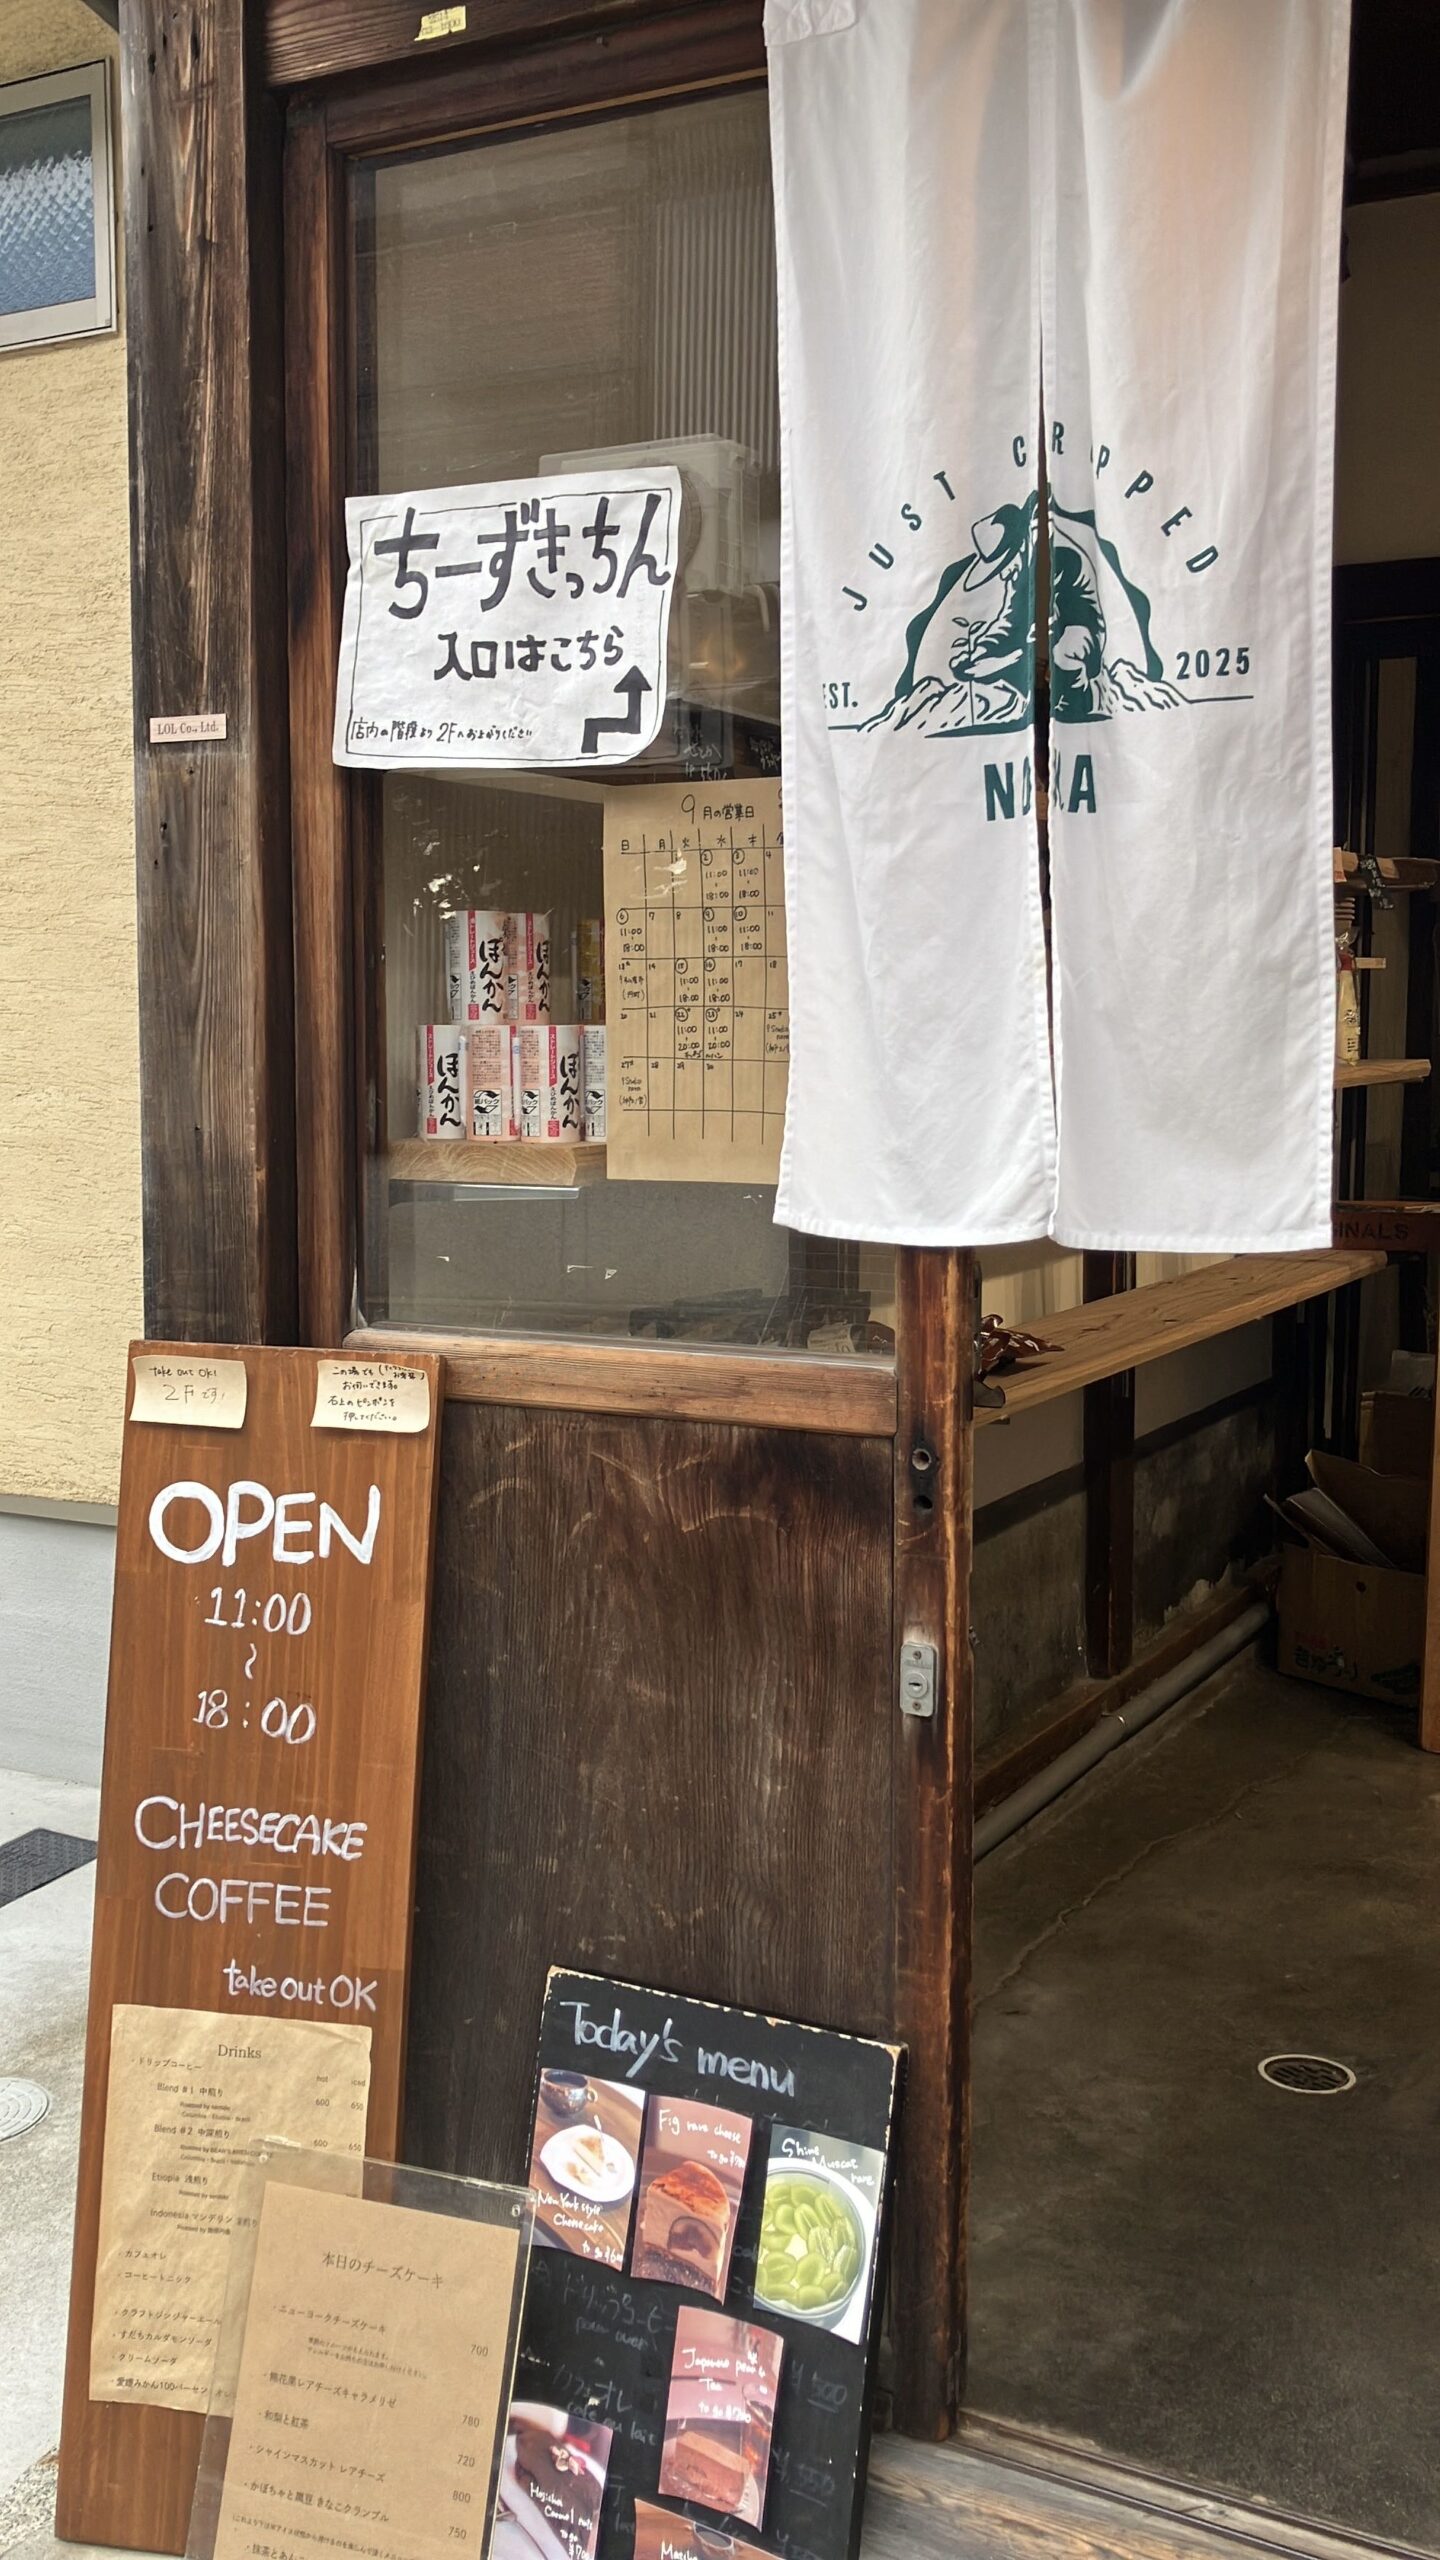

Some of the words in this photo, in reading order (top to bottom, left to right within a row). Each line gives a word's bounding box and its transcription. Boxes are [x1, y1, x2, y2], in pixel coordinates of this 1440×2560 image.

[842, 471, 956, 612] JUST
[1013, 421, 1219, 573] CRPPED
[374, 492, 671, 619] ちーずきっちん
[434, 625, 624, 681] 入口はこちら
[1176, 648, 1250, 680] 2025
[822, 682, 858, 709] ST.
[158, 723, 177, 735] LOL
[200, 721, 219, 733] Ltd.
[621, 839, 630, 851] 日
[658, 838, 666, 850] 月
[716, 834, 726, 847] 水
[1334, 1220, 1410, 1241] INALS
[149, 1480, 381, 1567] OPEN
[205, 1586, 313, 1635] 11:00
[134, 1795, 369, 1861] CHEESECAKE
[155, 1872, 332, 1928] COFFEE
[328, 1973, 378, 2012] OK
[218, 2044, 262, 2059] Drinks
[560, 2001, 684, 2078] Today's
[697, 2046, 795, 2098] menu
[140, 2058, 202, 2071] ドリップコーヒー
[157, 2082, 179, 2093] Blend
[315, 2098, 330, 2107] 600
[351, 2101, 365, 2111] 650
[154, 2123, 177, 2135] Blend
[659, 2109, 680, 2136] Fig
[313, 2139, 328, 2147] 600
[349, 2143, 362, 2151] 650
[192, 2213, 233, 2224] マンデリン
[124, 2250, 167, 2260] カフェオレ
[125, 2271, 192, 2284] コーヒートニック
[322, 2250, 445, 2289] 本日のチーズケーキ
[121, 2308, 222, 2325] クラフトジンジャーエール
[278, 2305, 386, 2336] ニューヨークチーズケーキ
[118, 2353, 178, 2366] クリームソーダ
[471, 2344, 489, 2357] 700
[264, 2409, 310, 2430] 和梨と紅茶
[462, 2415, 480, 2428] 780
[256, 2445, 335, 2471] シャインマスカット
[339, 2464, 386, 2483] レアチーズ
[457, 2454, 476, 2468] 720
[452, 2490, 471, 2504] 800
[316, 2496, 390, 2522] きなこクランブル
[448, 2526, 467, 2540] 750
